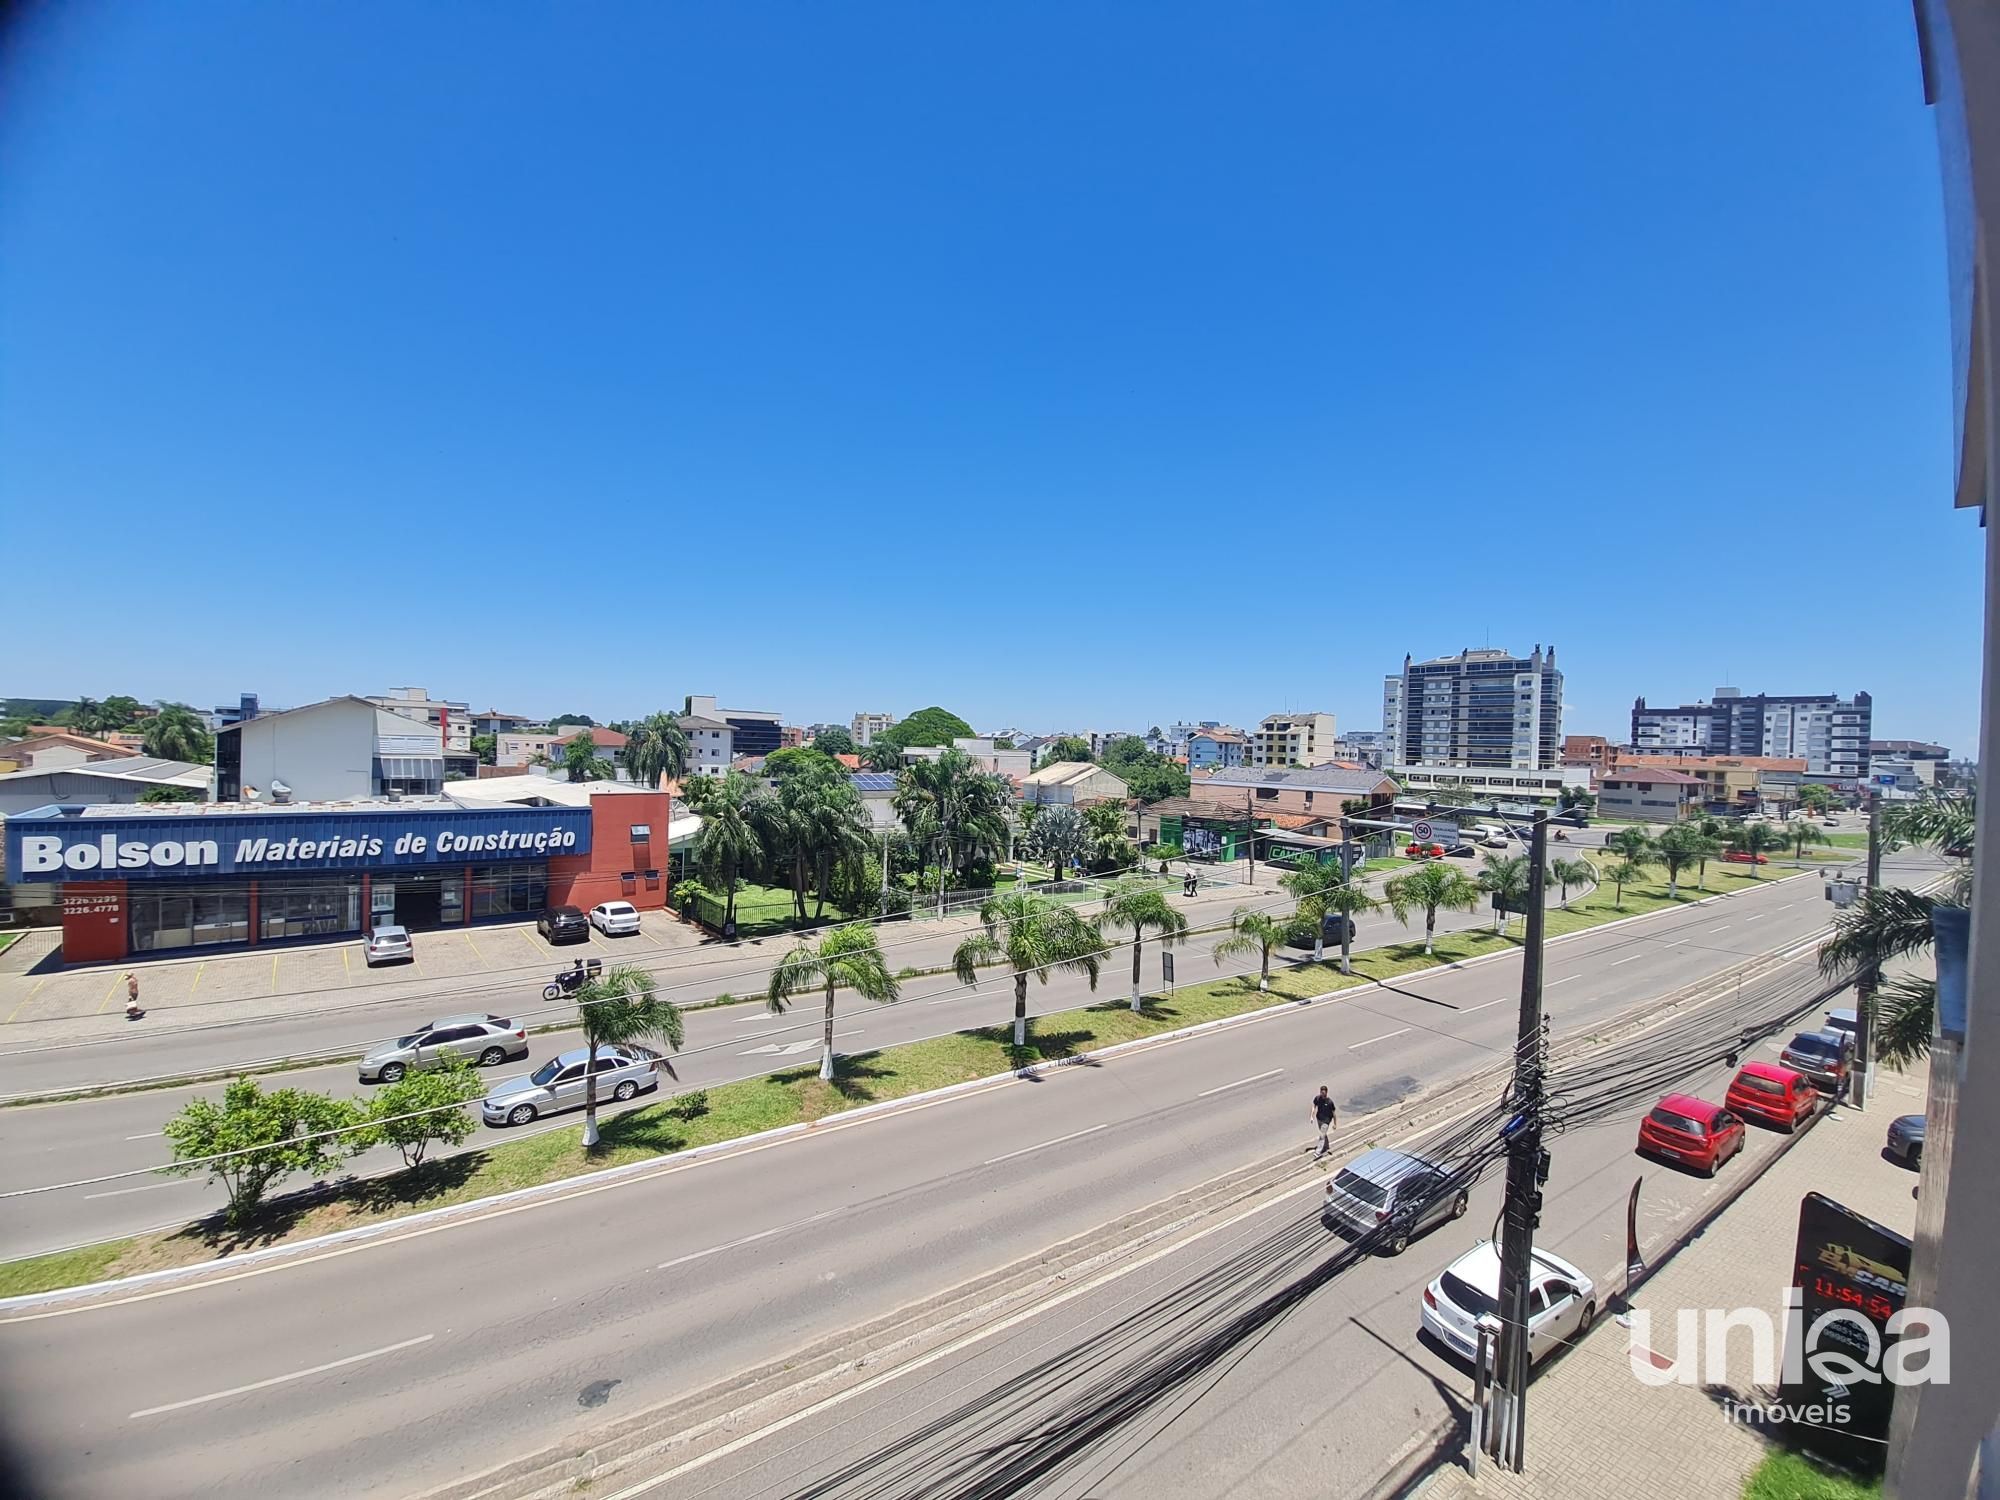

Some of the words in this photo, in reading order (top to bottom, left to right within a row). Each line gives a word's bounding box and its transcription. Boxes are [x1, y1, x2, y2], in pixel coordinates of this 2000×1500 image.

[22, 833, 218, 872] Bolson
[234, 834, 383, 863] Materiais
[394, 832, 427, 854] de
[436, 826, 576, 853] Construção
